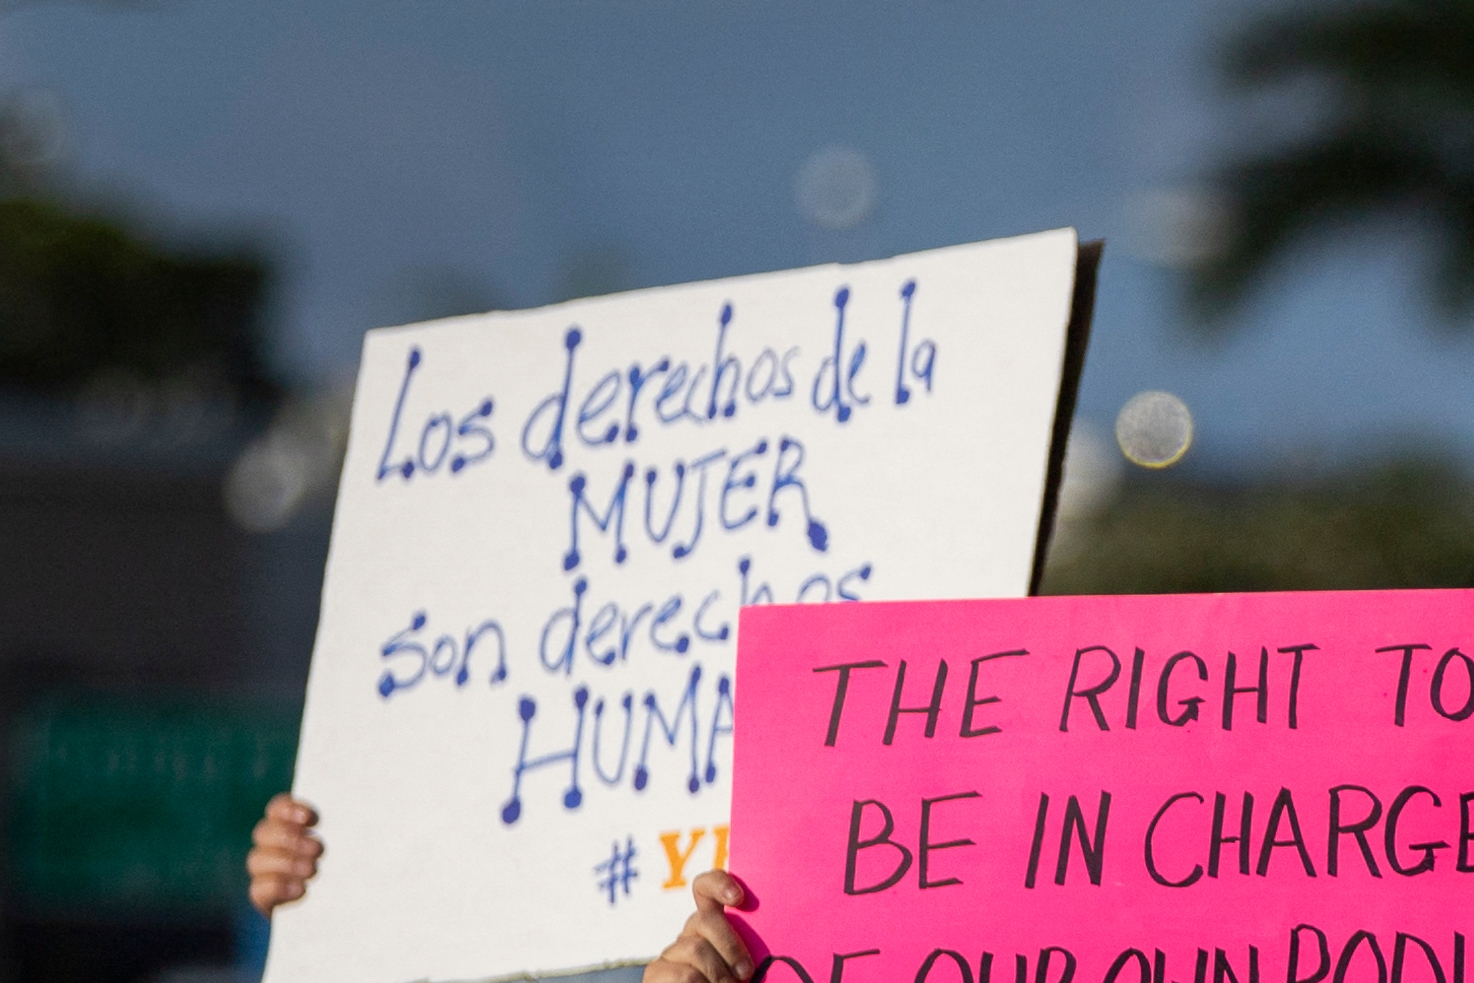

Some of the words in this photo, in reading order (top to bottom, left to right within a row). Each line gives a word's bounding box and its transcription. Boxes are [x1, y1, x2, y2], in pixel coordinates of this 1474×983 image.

[375, 347, 495, 483] Los
[521, 301, 801, 470] derechos
[811, 286, 870, 423] de
[893, 279, 937, 404] la
[563, 438, 828, 571] MUJER
[376, 611, 508, 698] son
[813, 648, 1029, 746] THE
[1060, 644, 1319, 732] RIGHT
[844, 791, 981, 896] BE
[1026, 791, 1111, 889] IN
